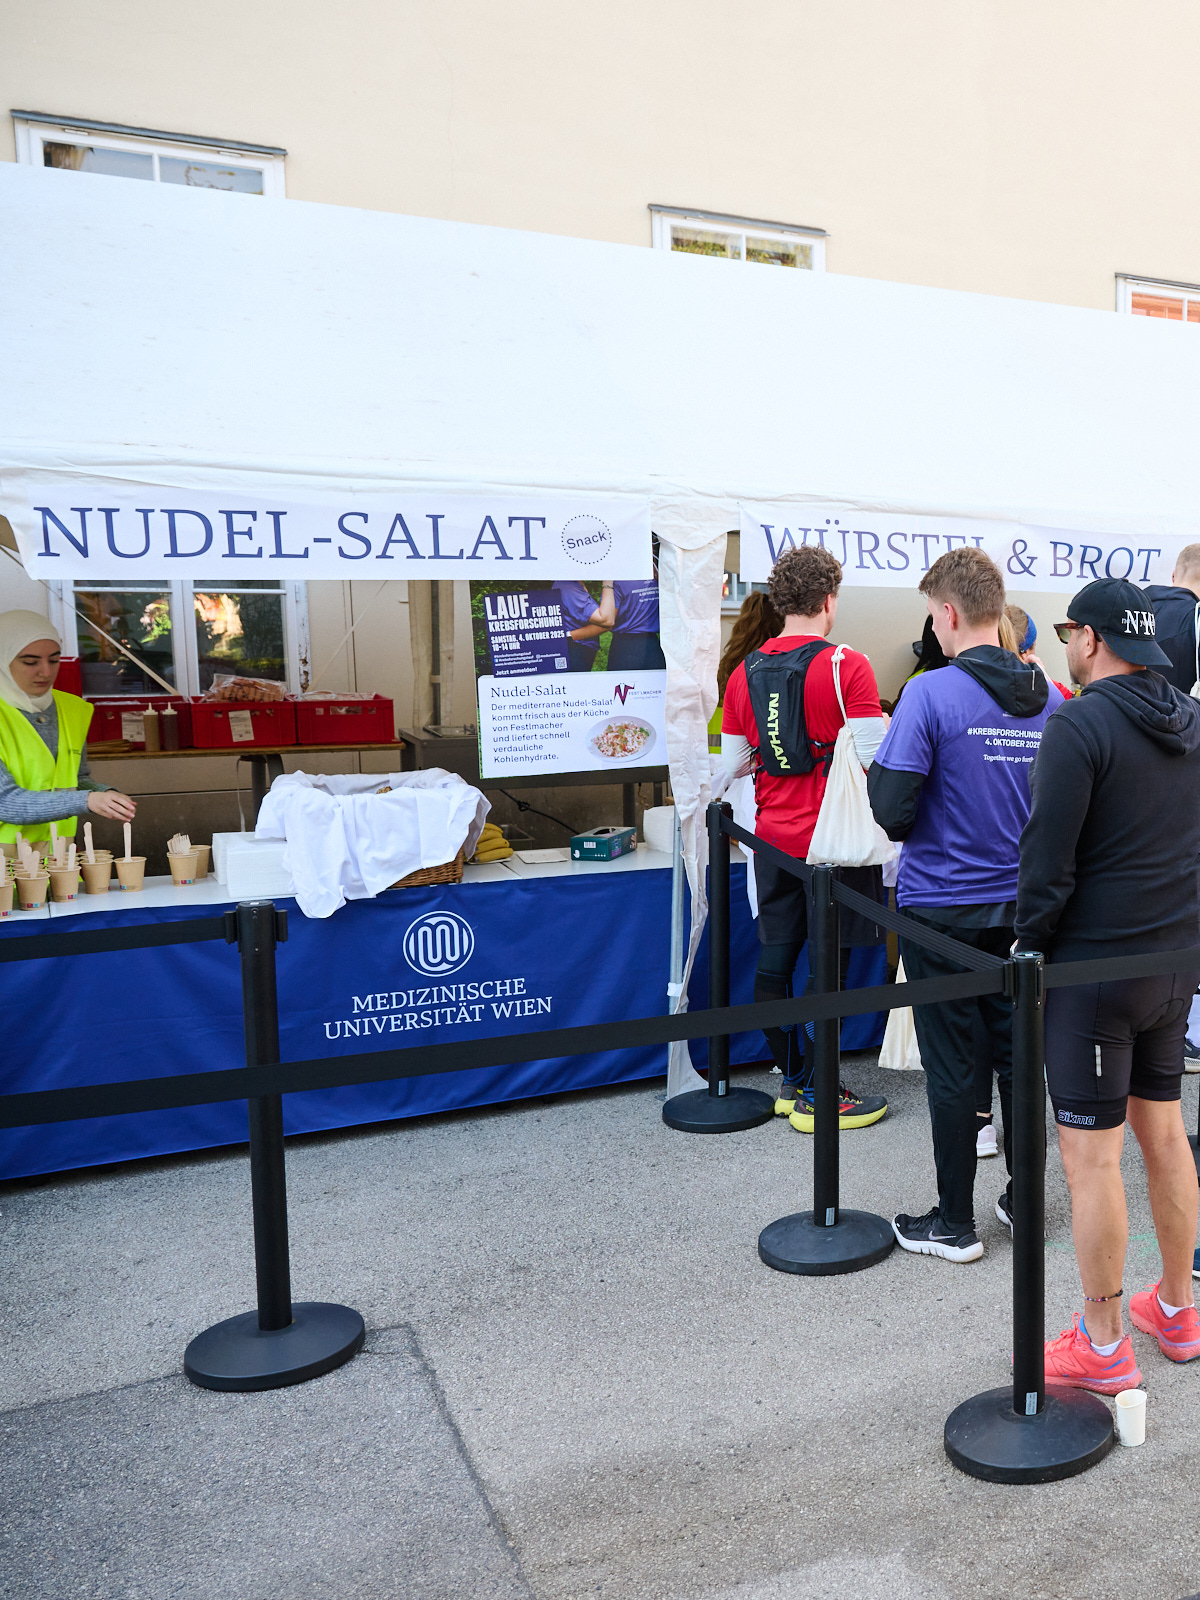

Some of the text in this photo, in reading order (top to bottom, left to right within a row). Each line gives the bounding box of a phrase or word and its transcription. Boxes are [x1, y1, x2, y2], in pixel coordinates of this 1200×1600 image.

[33, 506, 547, 560] NUDEL-SALAT
[566, 530, 608, 549] Snack
[760, 519, 1162, 582] WÜRST & BROT
[485, 594, 562, 620] LAUF FÜR DIE
[488, 616, 563, 632] KREBSFORSCHUNG!
[525, 631, 550, 641] OKTOBER
[550, 630, 565, 639] 2025
[491, 685, 567, 698] Nudel-Salat
[491, 699, 613, 711] Der mediterrane Nudel-Salat
[492, 713, 523, 722] kommt
[583, 709, 610, 717] Küche
[510, 722, 564, 731] Festlmacher
[767, 692, 791, 769] NATHAN
[967, 727, 1042, 739] #KREBSFORSCHUNGS
[511, 733, 538, 742] liefert
[539, 731, 570, 739] schnell
[993, 738, 1025, 748] OKTOBER
[493, 743, 543, 753] verdauliche
[494, 754, 559, 763] Kohlenhydrate.
[351, 978, 526, 1014] MEDIZINISCHE
[323, 996, 552, 1040] UNIVERSITÄT WIEN
[1058, 1109, 1096, 1126] Sikma
